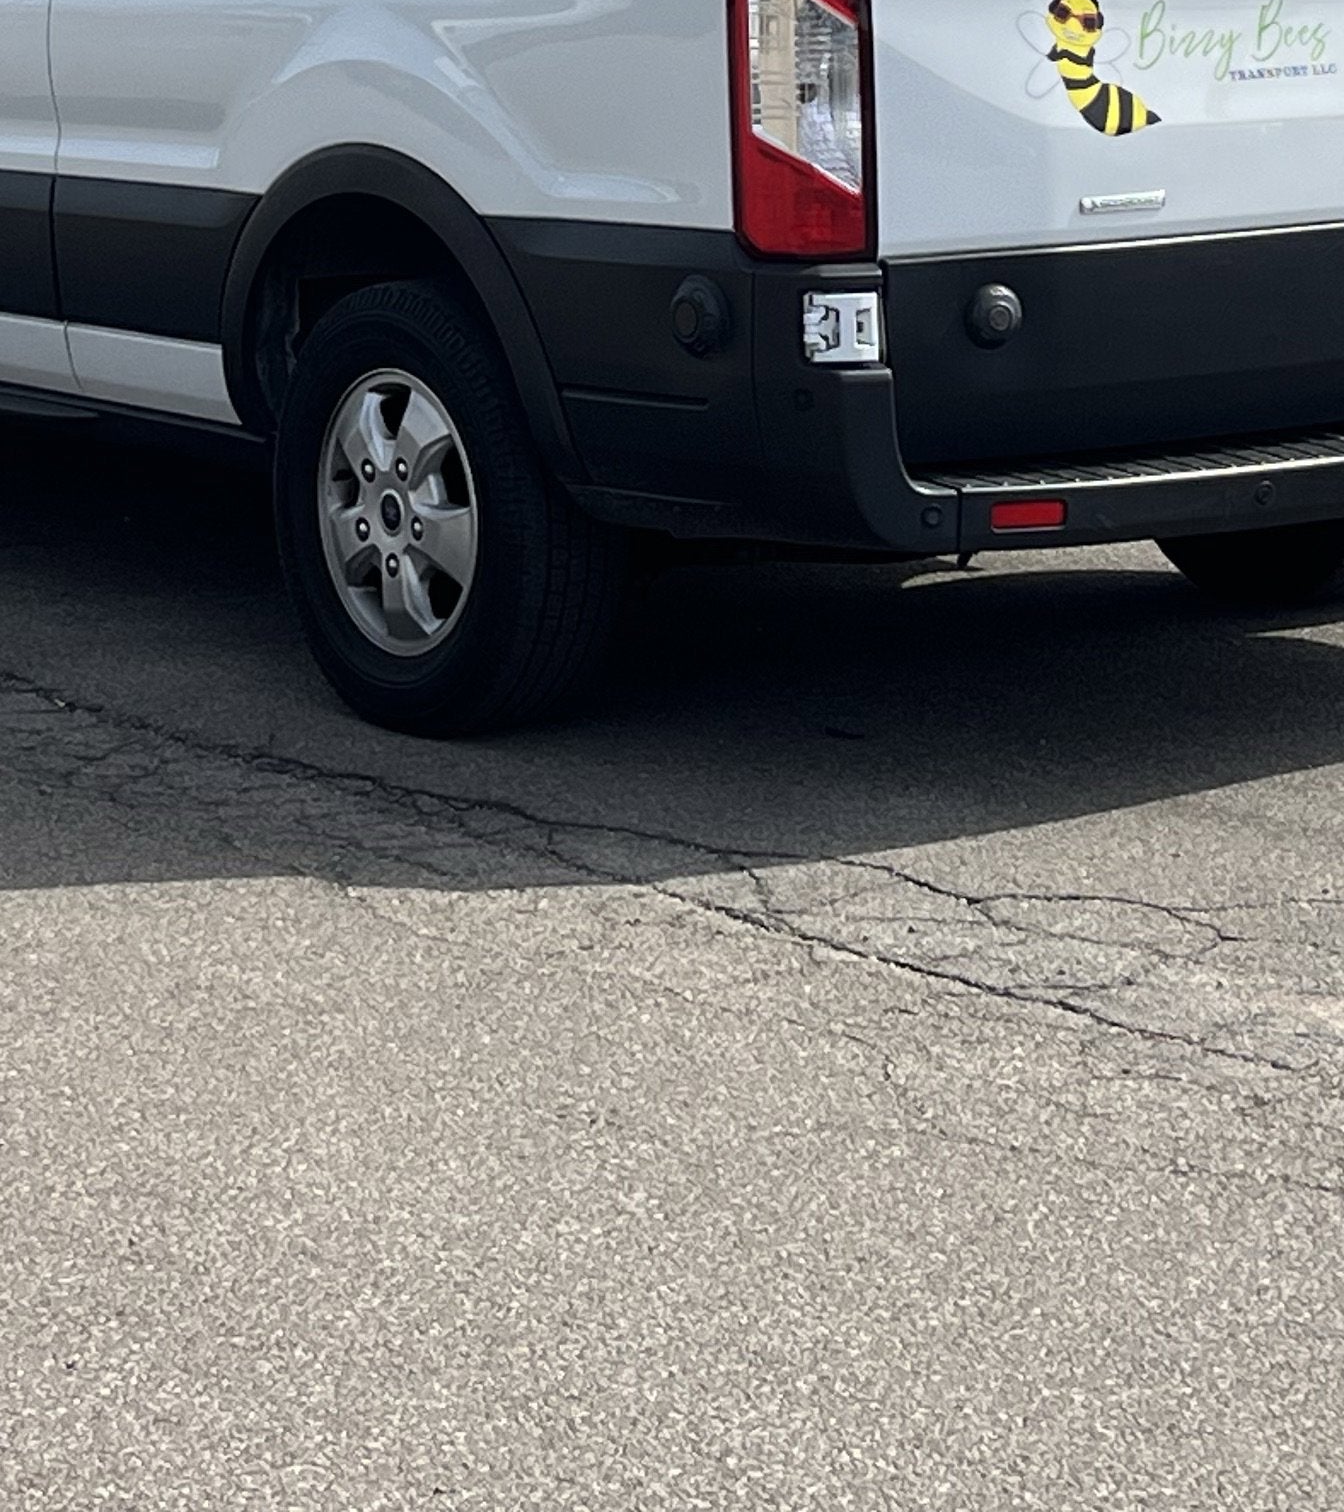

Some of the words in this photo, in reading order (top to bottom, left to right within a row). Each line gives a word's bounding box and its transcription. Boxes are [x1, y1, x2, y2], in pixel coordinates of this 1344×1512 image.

[1133, 0, 1242, 82] Bizzy
[1228, 64, 1308, 82] TRANSPORT
[1311, 62, 1338, 76] LLC
